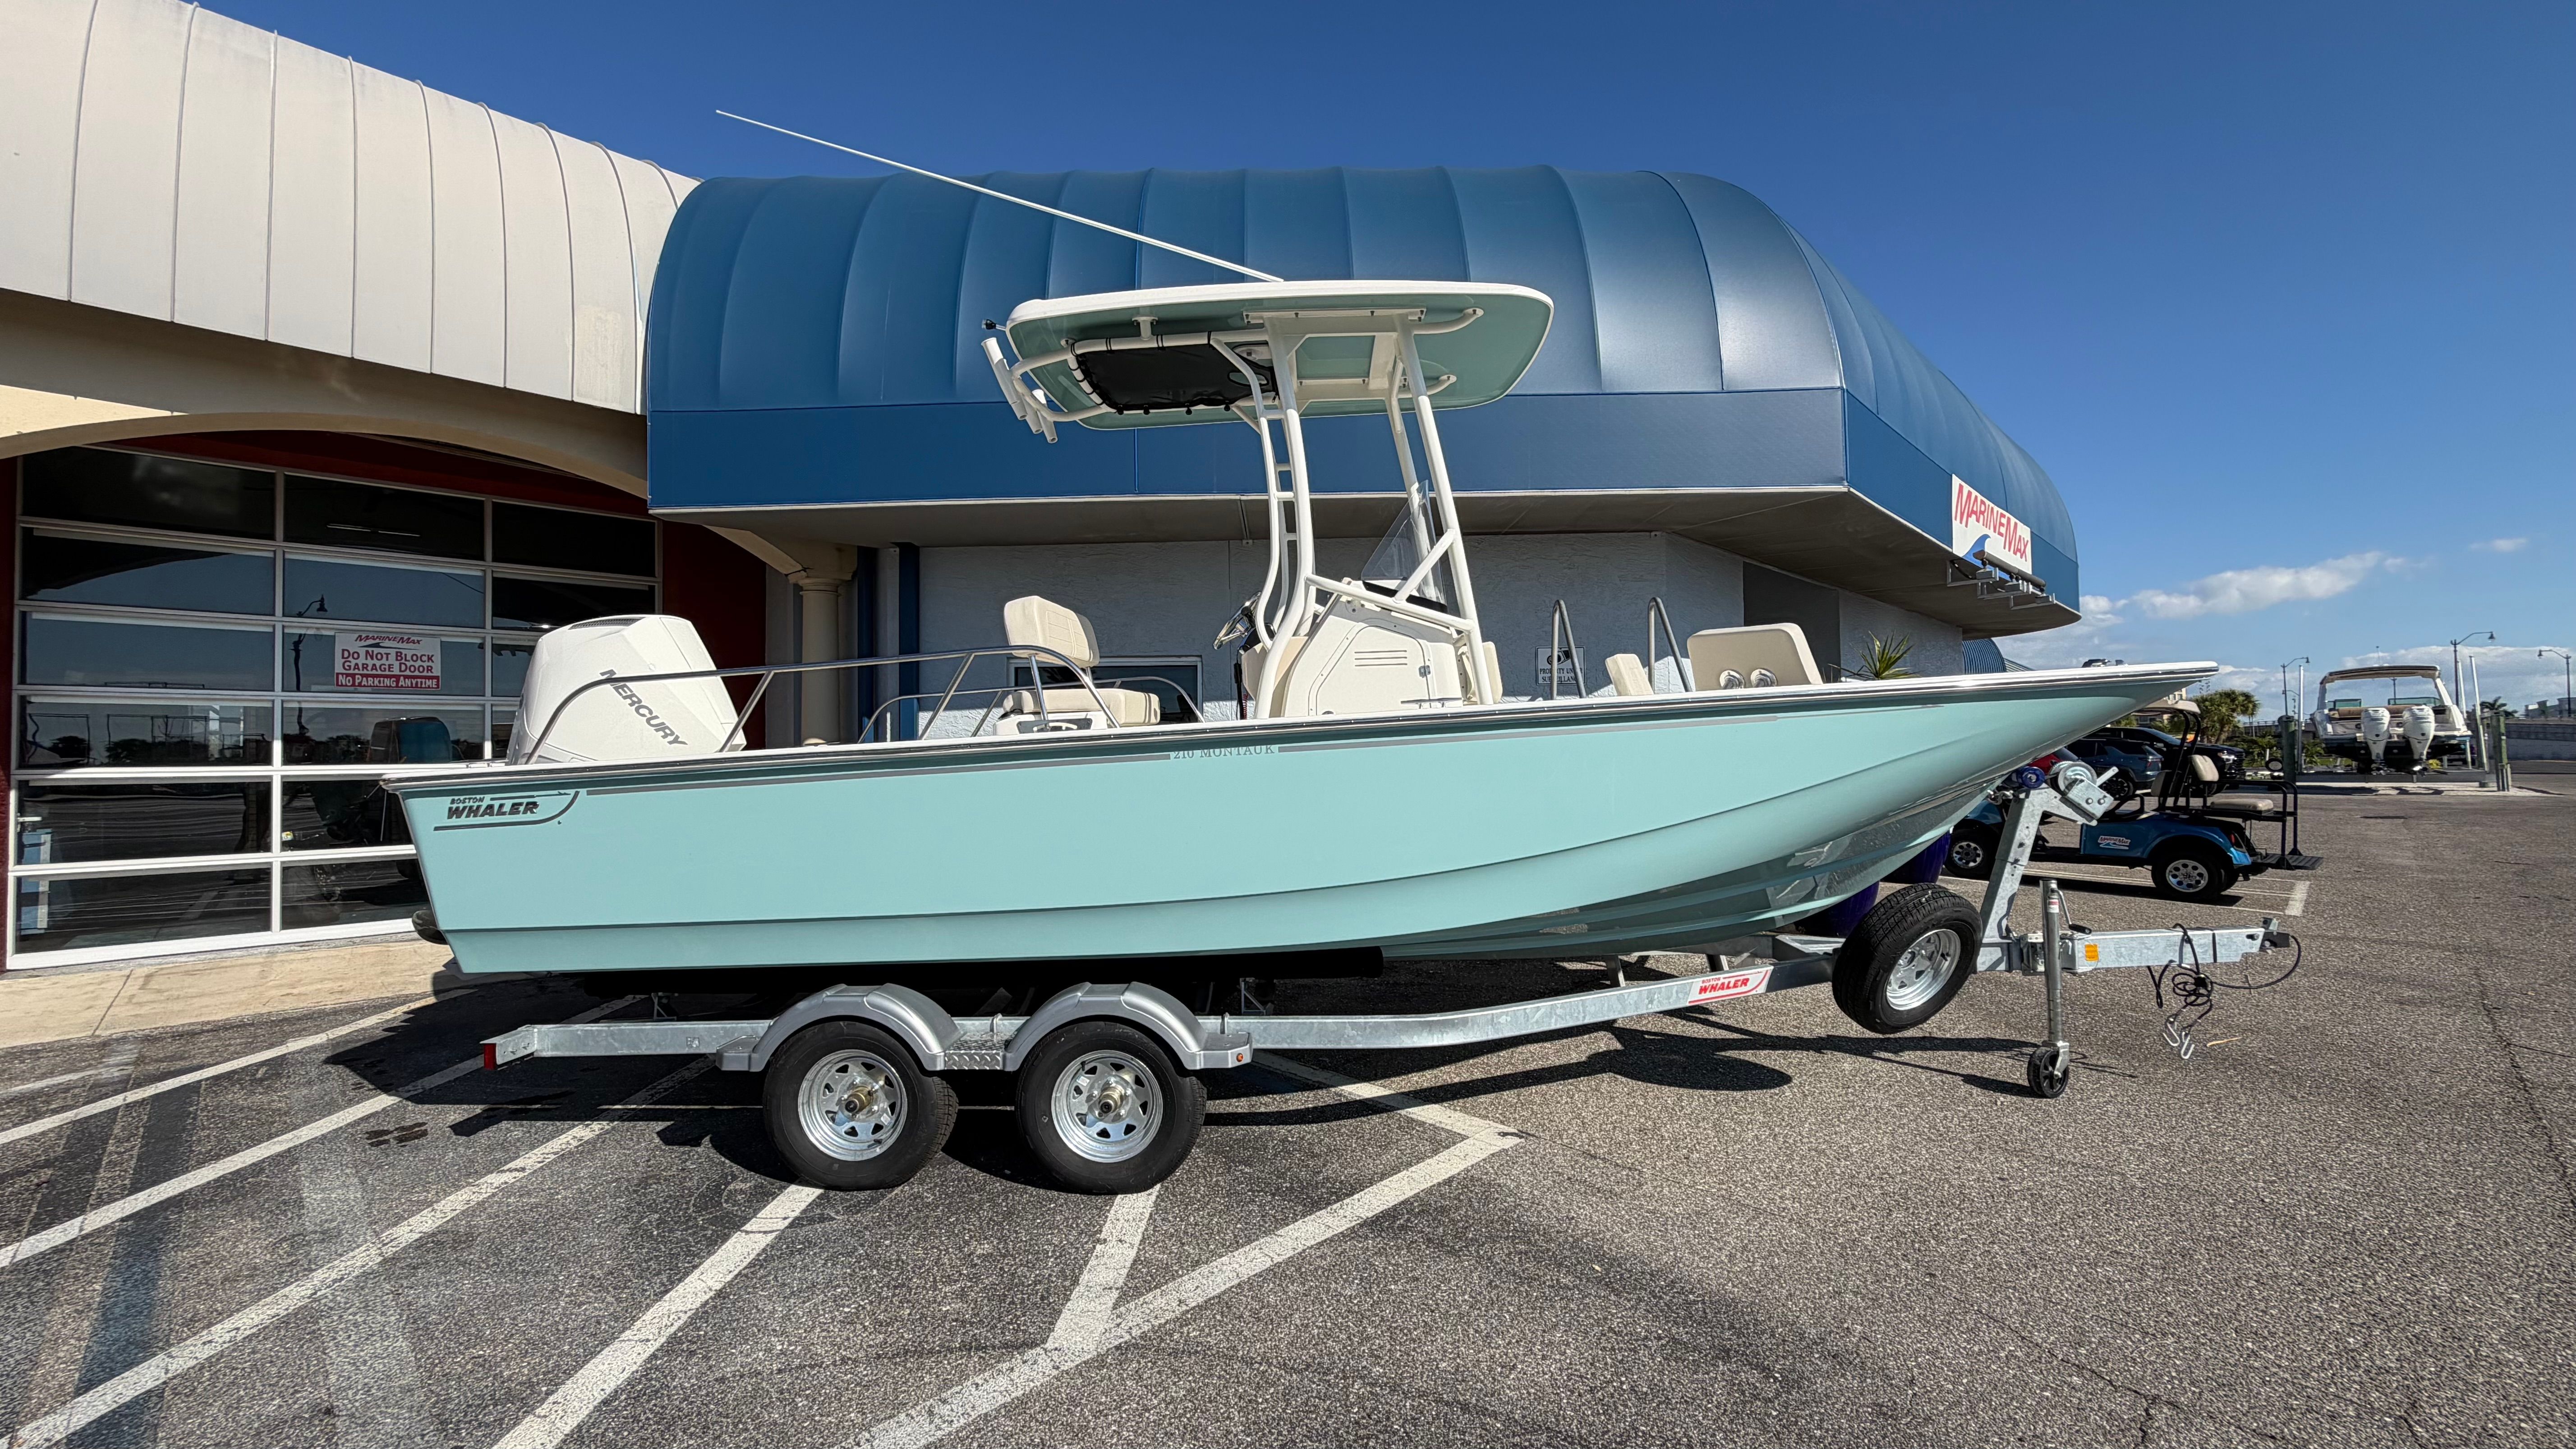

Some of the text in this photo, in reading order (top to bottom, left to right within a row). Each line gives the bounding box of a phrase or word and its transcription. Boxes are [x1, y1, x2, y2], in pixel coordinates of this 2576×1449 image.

[341, 649, 434, 663] DO NOT BLOCK
[342, 660, 433, 673] GARAGE DOOR
[339, 674, 437, 688] NO PARKING ANYTIME
[1173, 745, 1275, 759] 210 MONTAUK
[450, 796, 485, 805] BOSTON
[447, 801, 539, 819] WHALER
[1698, 978, 1750, 995] WHALER
